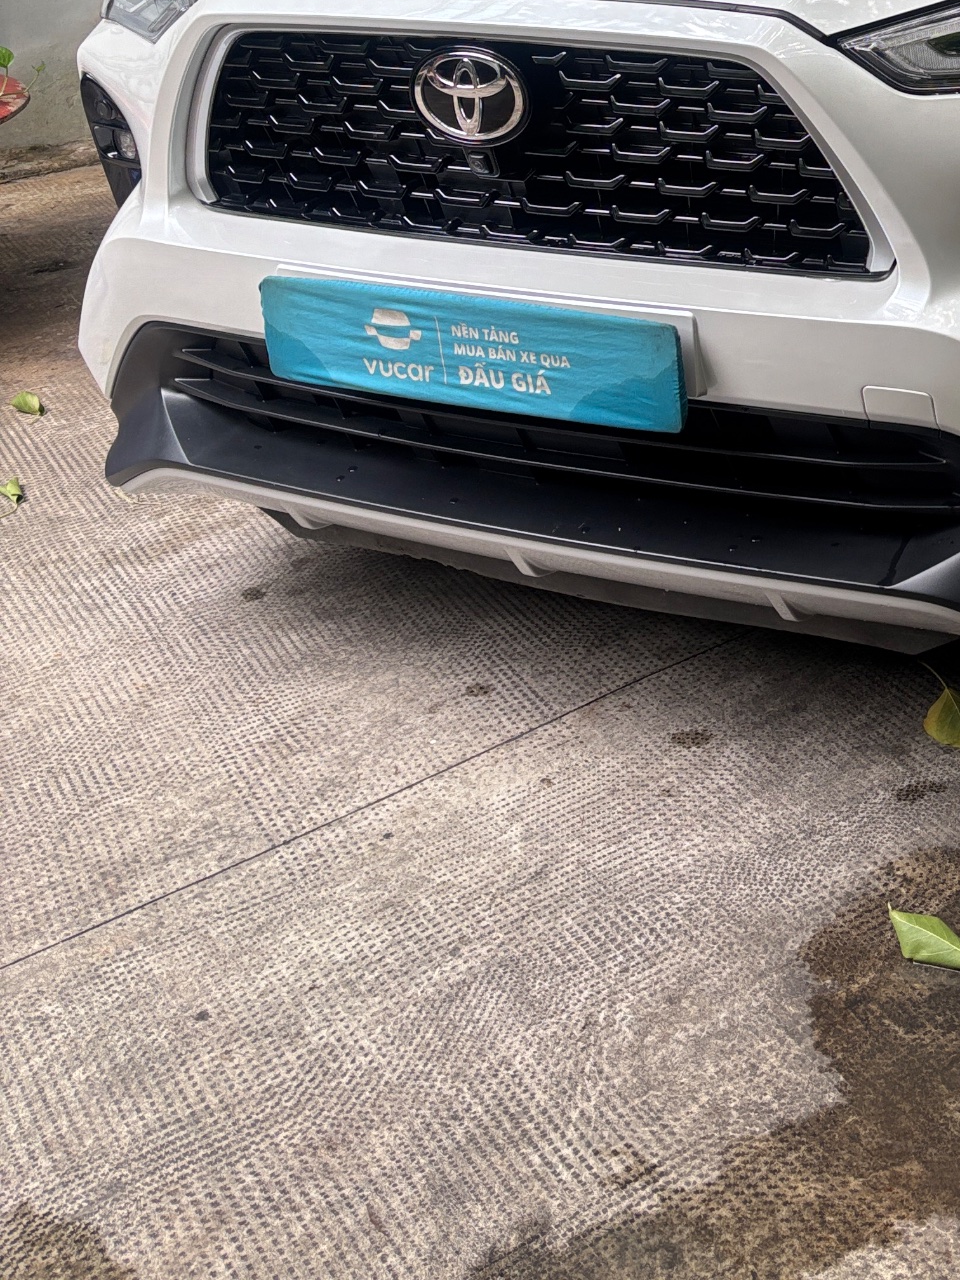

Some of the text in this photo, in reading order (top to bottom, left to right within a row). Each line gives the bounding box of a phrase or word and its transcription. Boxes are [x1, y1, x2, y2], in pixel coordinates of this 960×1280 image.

[451, 322, 519, 345] NỀN TẢNG
[453, 343, 571, 368] MUA BÁN XE QUA
[363, 358, 434, 383] vucar
[458, 362, 552, 396] ĐẤU GIÁ
